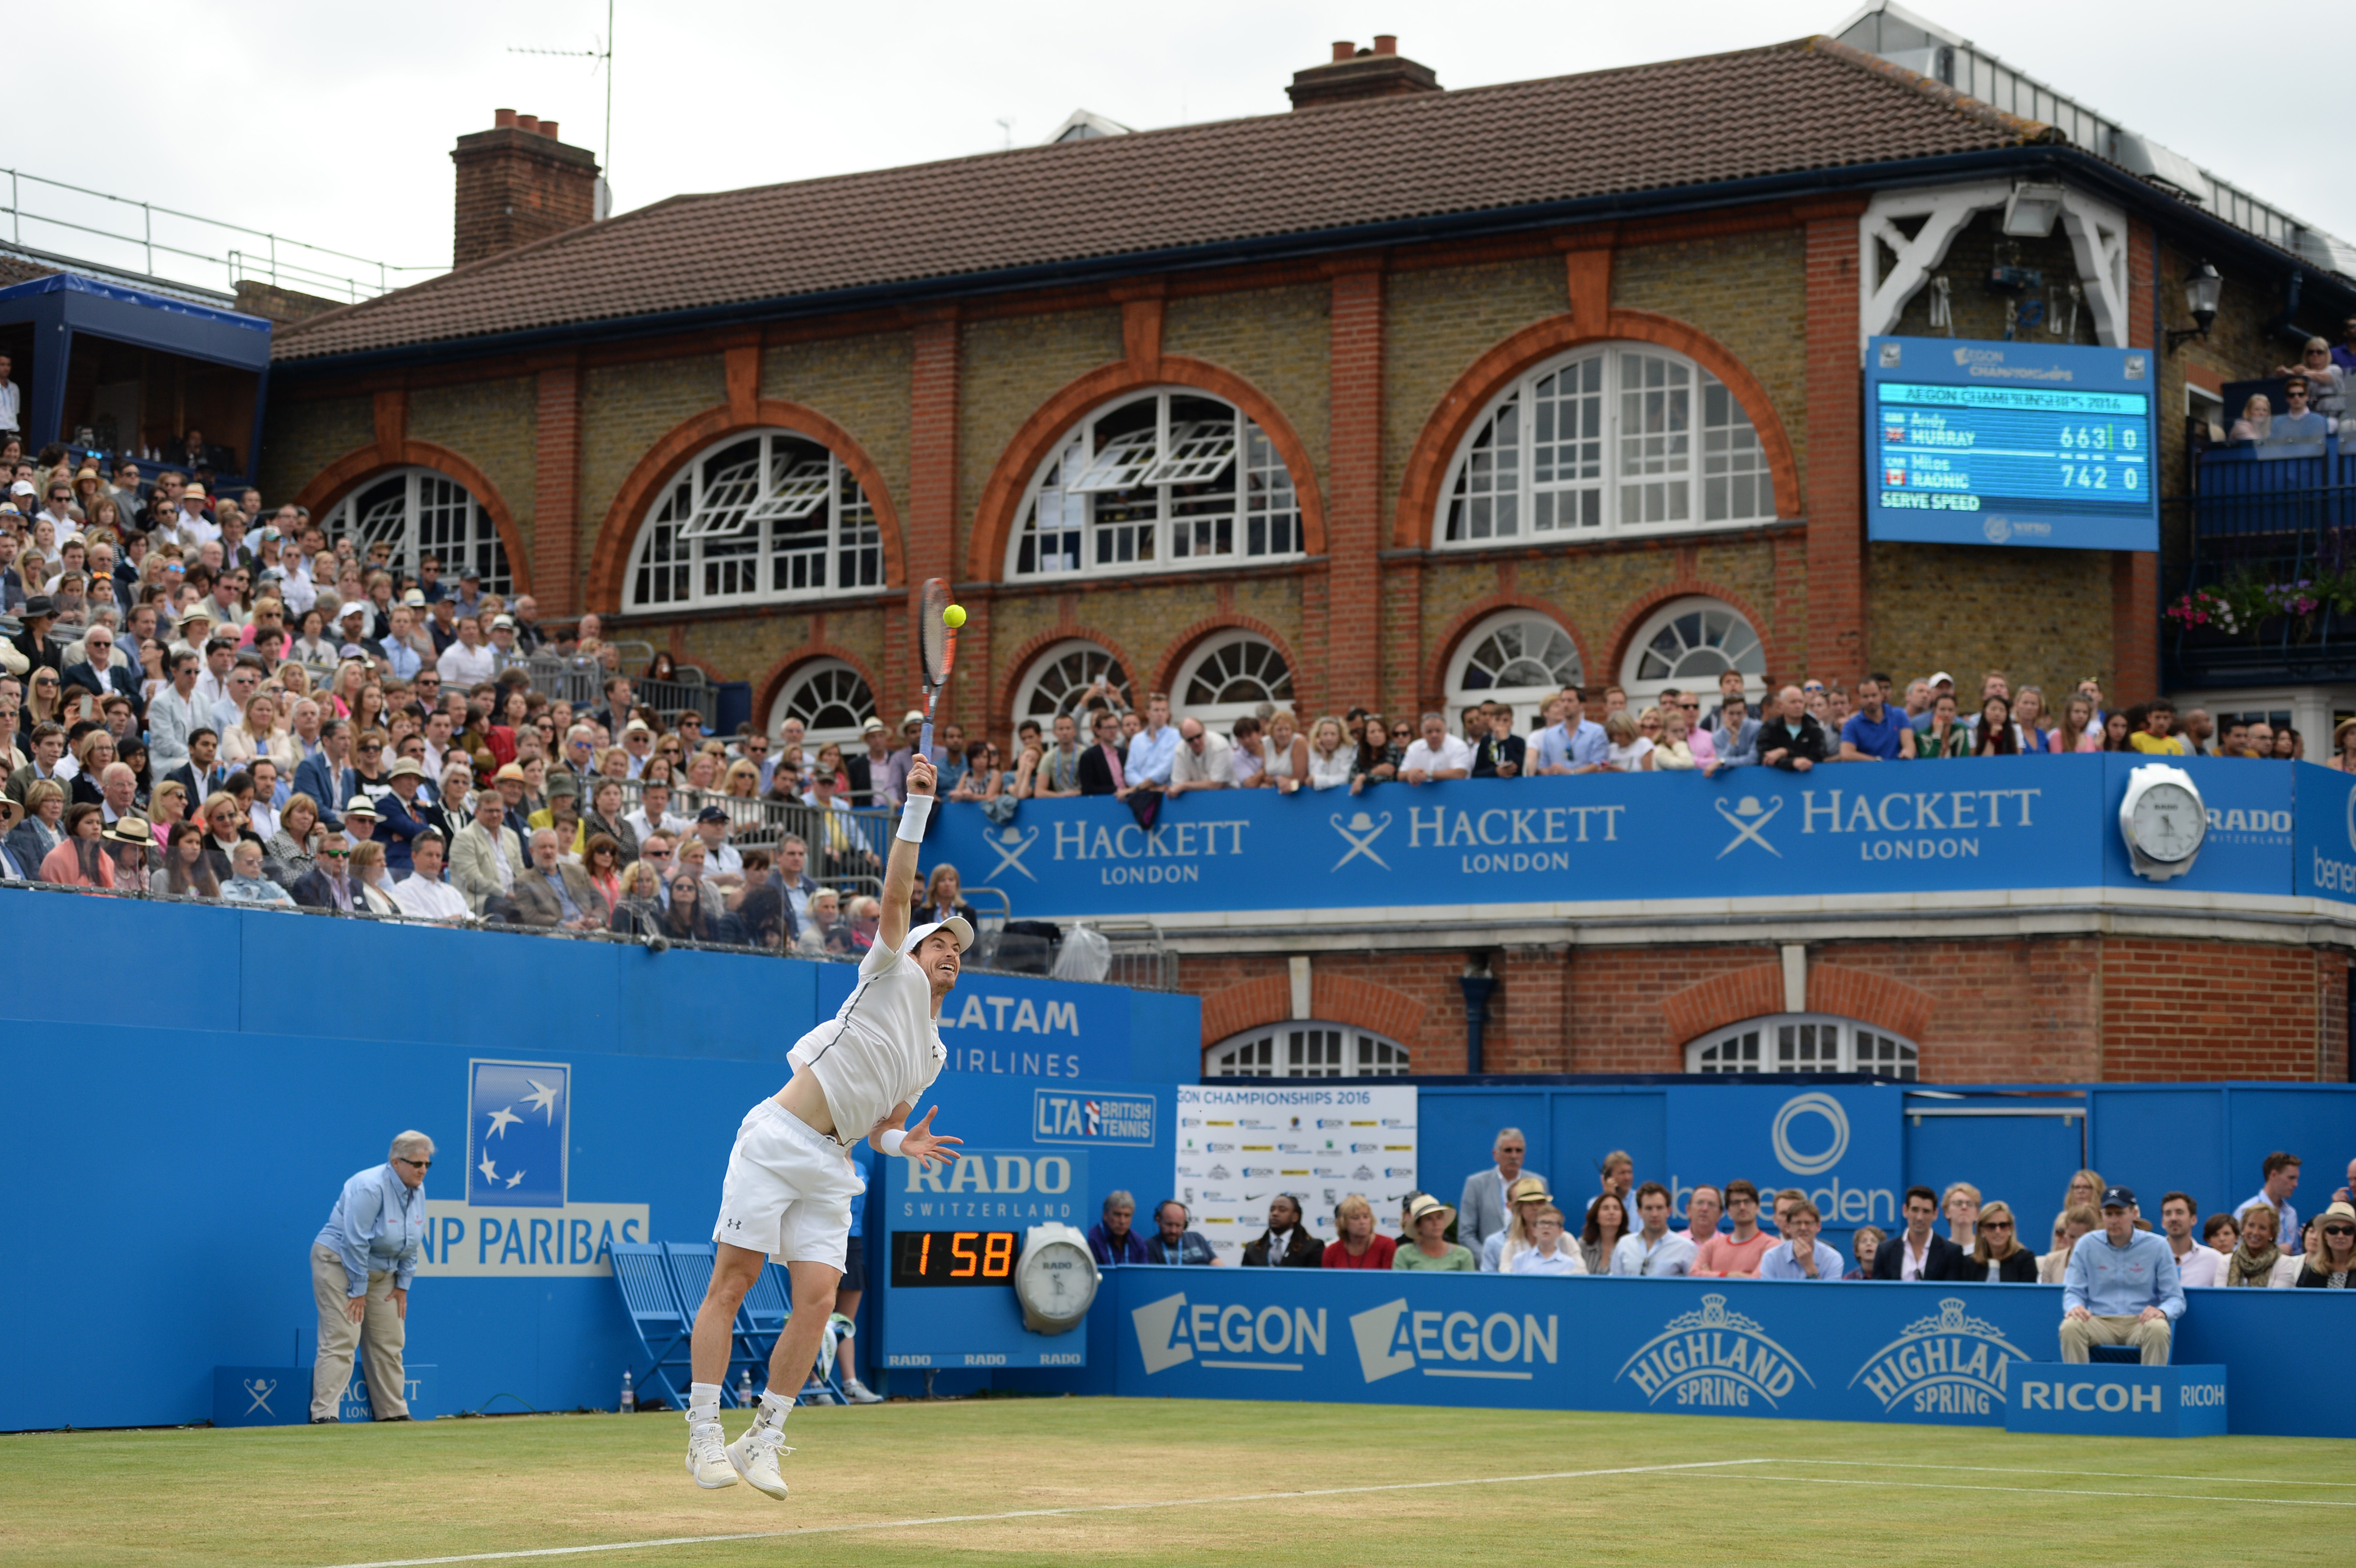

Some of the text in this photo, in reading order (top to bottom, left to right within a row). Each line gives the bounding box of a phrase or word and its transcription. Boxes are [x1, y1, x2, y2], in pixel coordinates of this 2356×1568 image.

[1906, 389, 1957, 401] AEGON
[1962, 391, 2083, 408] CHAMPIONSHIPS
[1911, 412, 1947, 431] Andy
[1911, 429, 1976, 446] MURRAY
[2122, 429, 2137, 450] 0
[1911, 454, 1951, 471] Milos
[1912, 471, 1970, 490] RAONIC
[2124, 468, 2138, 489] 0
[1880, 491, 1981, 511] SERVE SPEED
[1801, 788, 2041, 834] HACKETT
[2206, 808, 2292, 833] RADO
[1408, 805, 1625, 848] HACKETT
[1053, 820, 1251, 860] HACKETT
[1861, 838, 1979, 861] LONDON
[2209, 834, 2292, 846] WITZERLAND
[1462, 852, 1569, 873] LONDON
[1102, 864, 1199, 885] LONDON
[936, 994, 1080, 1037] LATAM
[1204, 1091, 1332, 1105] CHAMPIONSHIPS
[1337, 1091, 1371, 1105] 2016
[1038, 1098, 1083, 1136] LTA
[1101, 1101, 1151, 1120] BRITISH
[1101, 1119, 1150, 1138] TENNIS
[904, 1155, 1071, 1194] RADO
[904, 1202, 1070, 1218] SWITZERLAND
[414, 1217, 465, 1265] NP
[919, 1232, 931, 1275] 1
[1168, 1304, 1327, 1356] AEGON
[1387, 1310, 1558, 1364] AEGON
[889, 1355, 931, 1366] RADO
[965, 1354, 1006, 1365] RADO
[1040, 1353, 1081, 1365] RADO
[1628, 1331, 1796, 1399] HIGHLAND
[1863, 1338, 2009, 1405] HIGHLAN
[1677, 1376, 1749, 1407] SPRING
[1914, 1384, 1990, 1416] SPRING
[2022, 1381, 2161, 1413] RICOH
[2181, 1384, 2225, 1407] RICOH
[346, 1406, 374, 1418] LON
